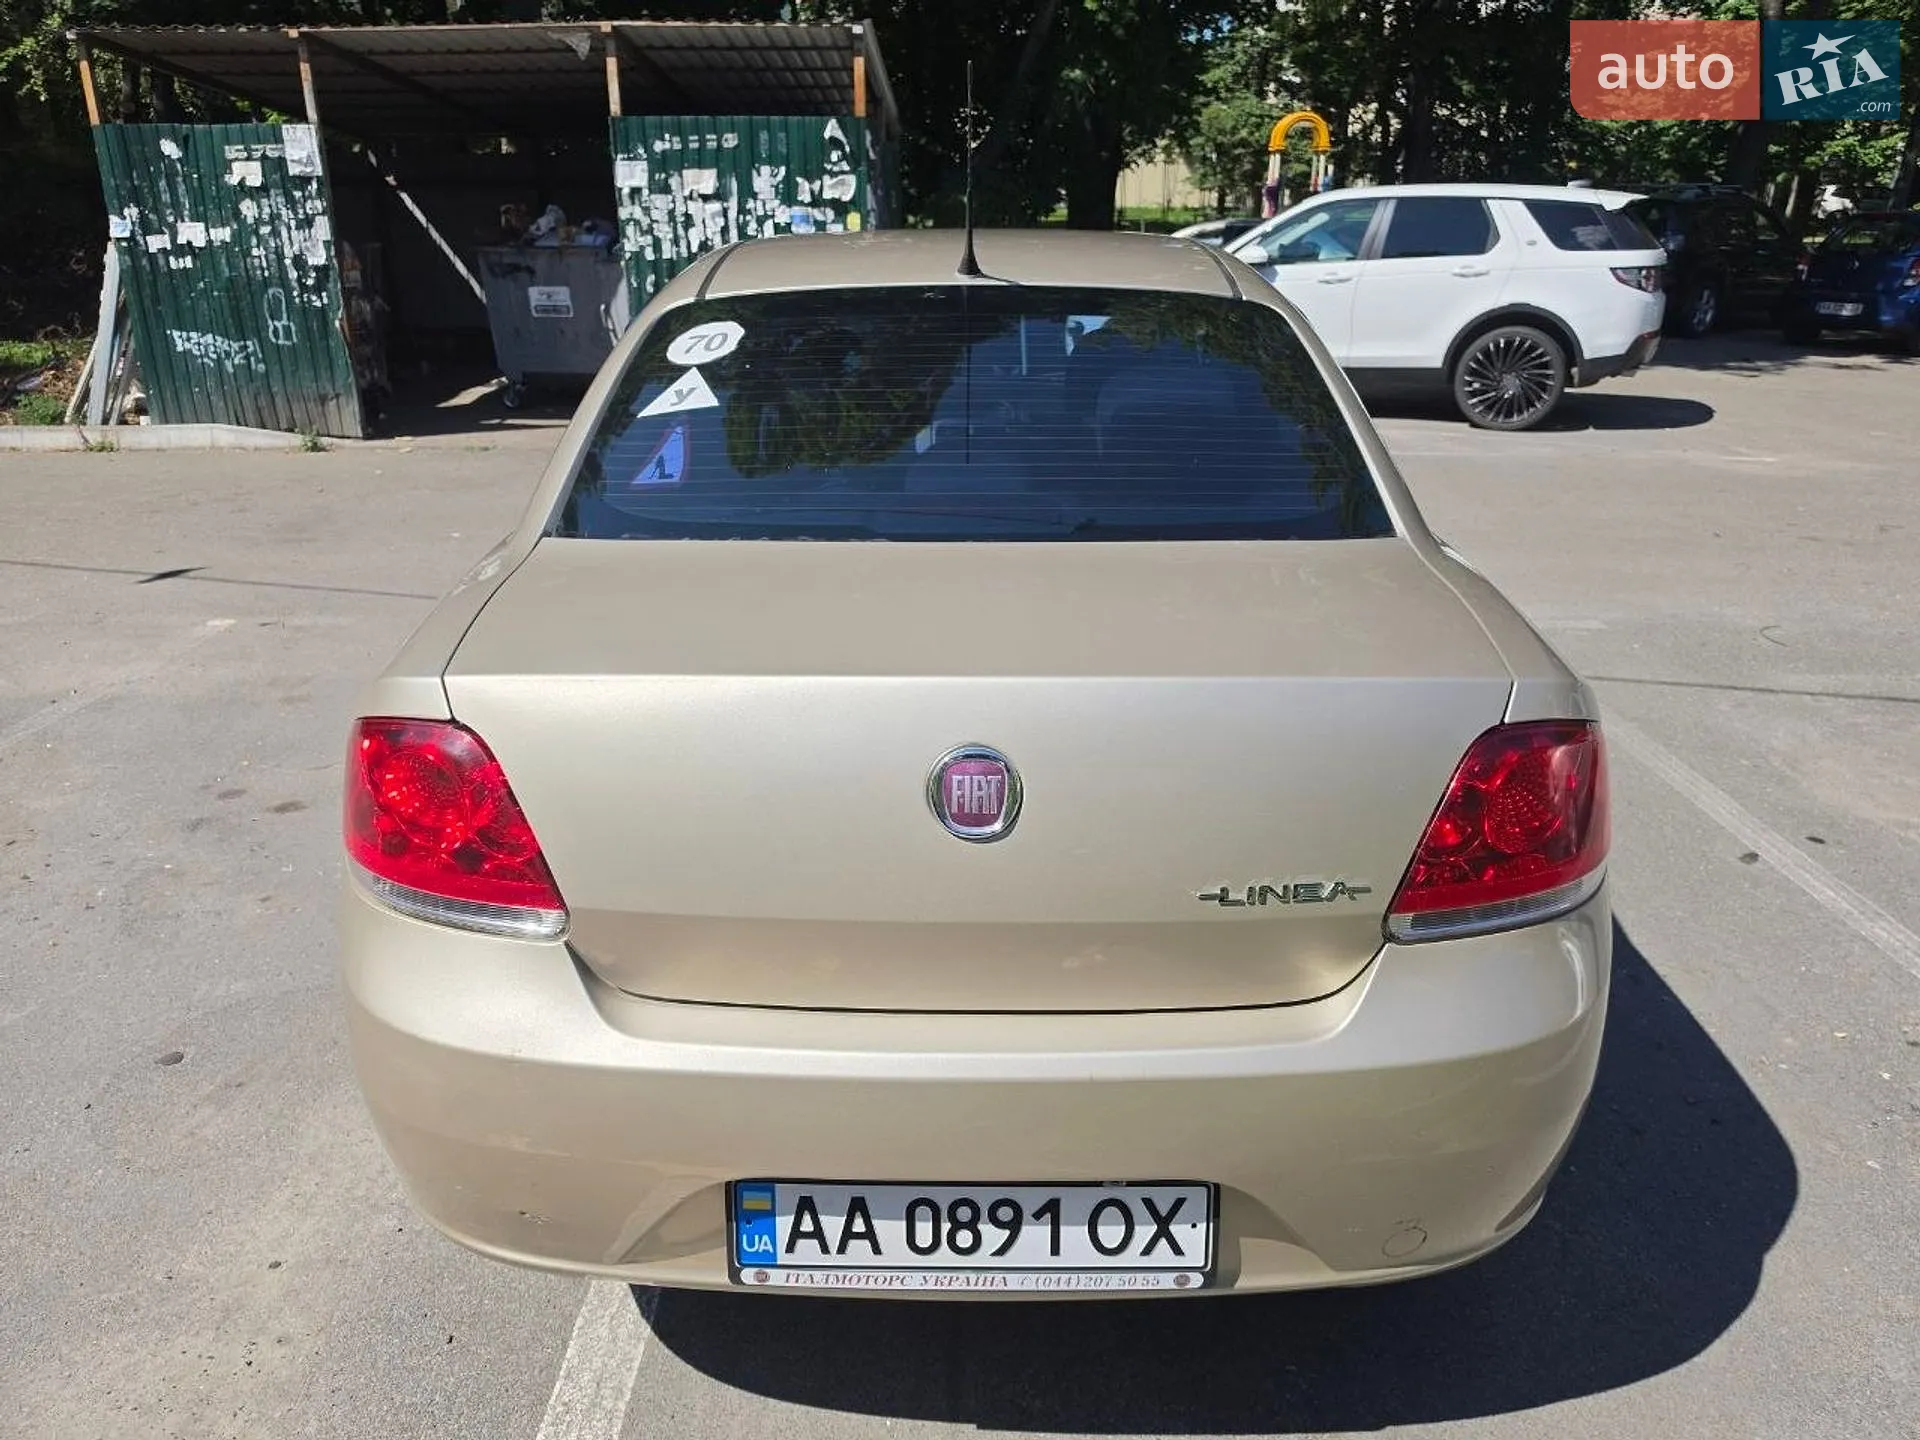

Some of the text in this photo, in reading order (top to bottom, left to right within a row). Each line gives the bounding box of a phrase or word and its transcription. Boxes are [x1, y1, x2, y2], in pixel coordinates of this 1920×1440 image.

[684, 332, 729, 354] 70
[951, 774, 1002, 815] FIAT
[1218, 881, 1359, 907] LINEA
[784, 1195, 1188, 1257] AA 0891 OX
[742, 1234, 774, 1254] UA
[920, 1272, 1008, 1288] УКРАЇНА
